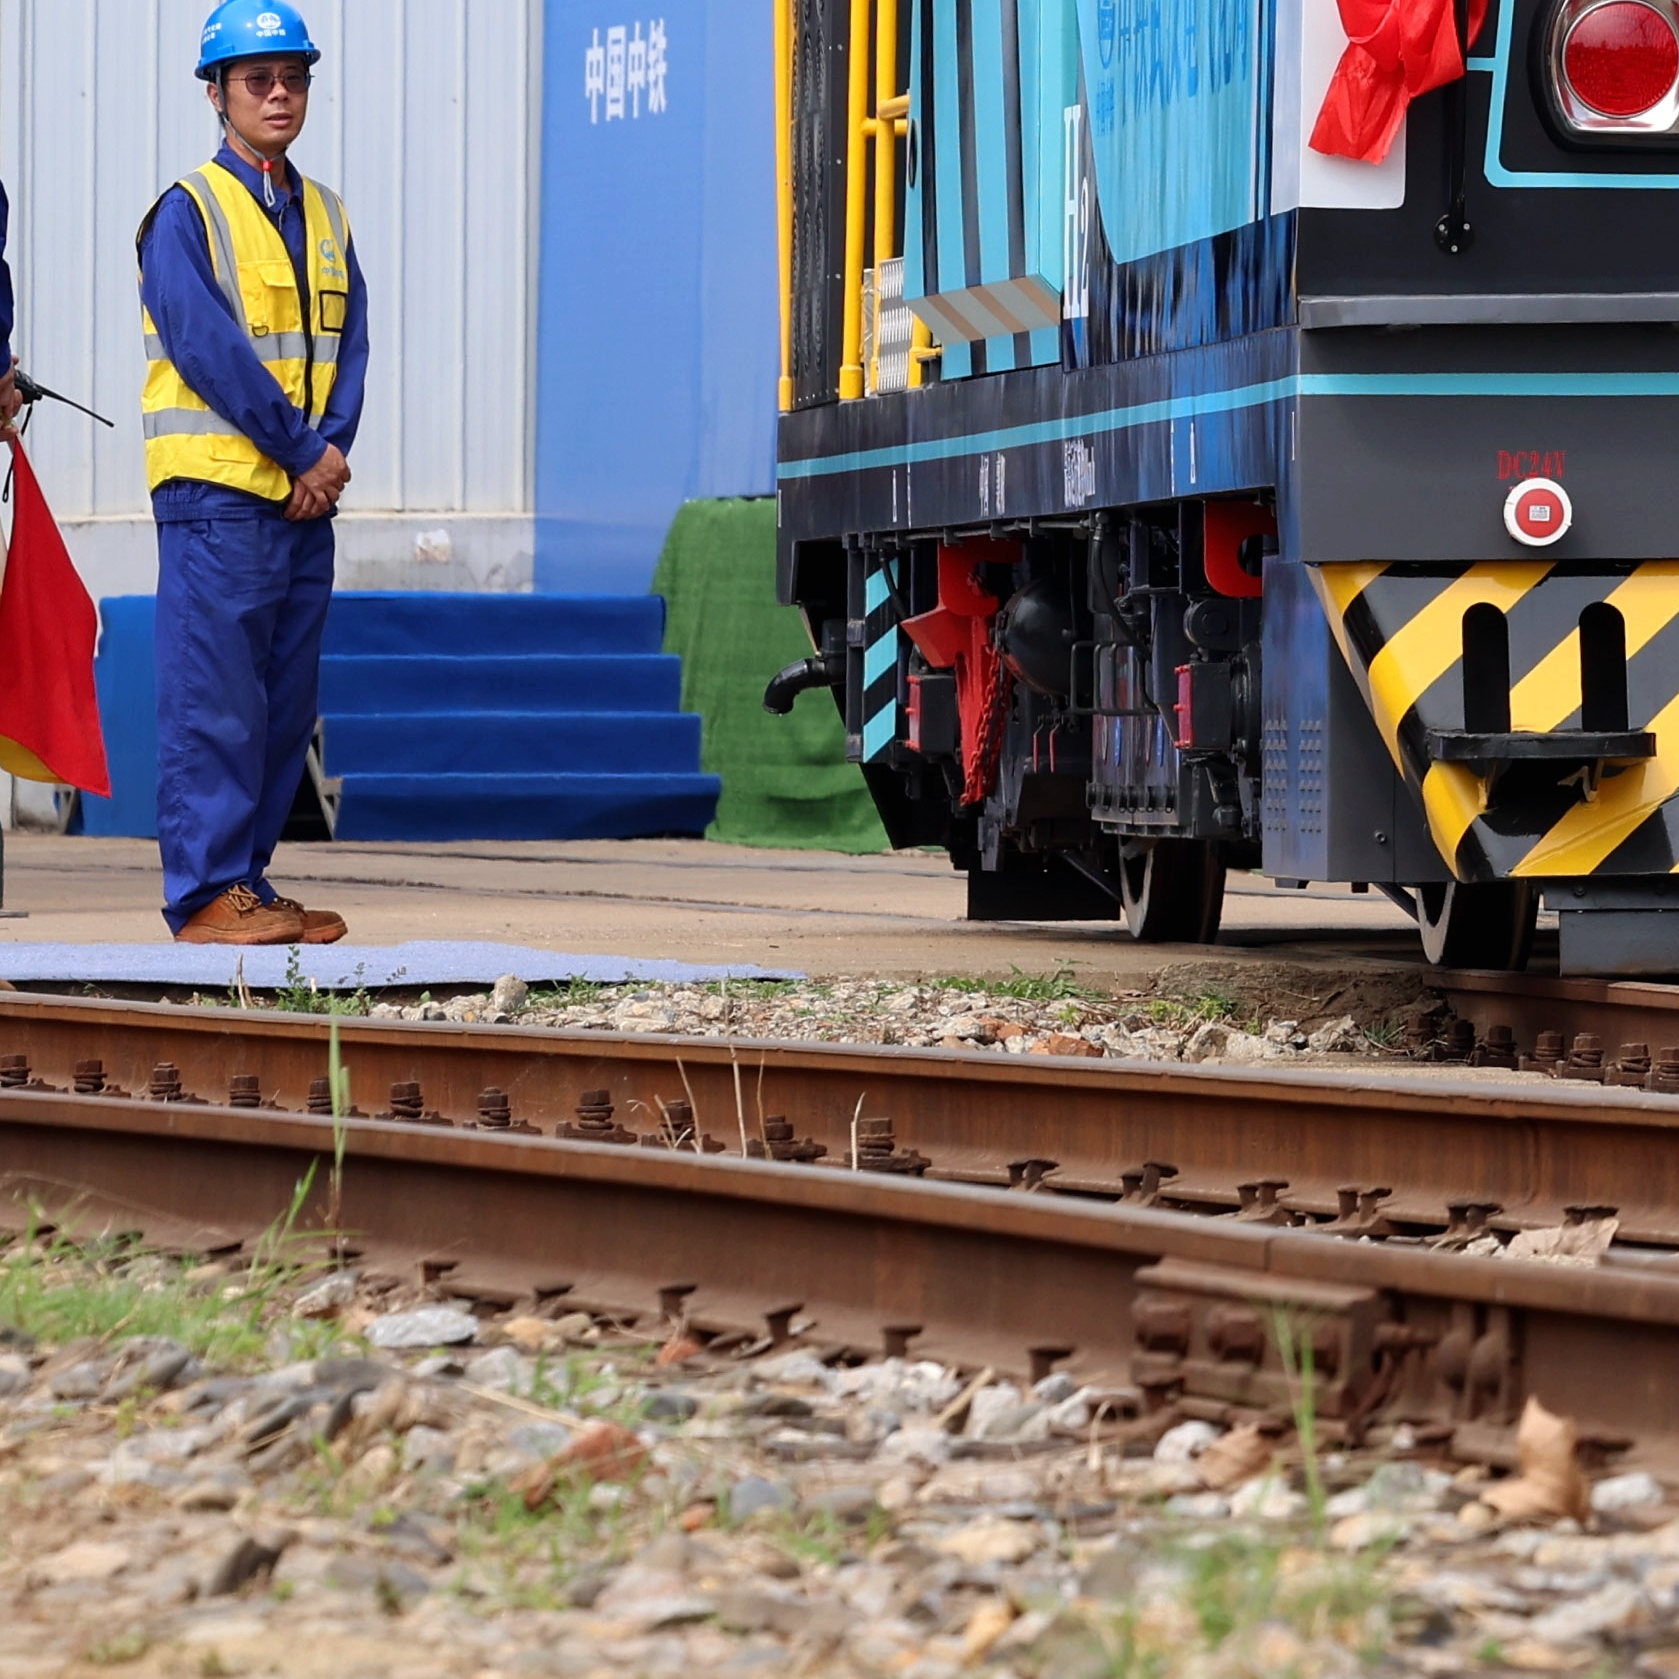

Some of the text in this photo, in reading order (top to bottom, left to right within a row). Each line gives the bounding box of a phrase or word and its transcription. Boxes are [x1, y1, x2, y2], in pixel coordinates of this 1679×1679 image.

[584, 17, 668, 125] 中国中铁
[1496, 449, 1568, 480] DC24V
